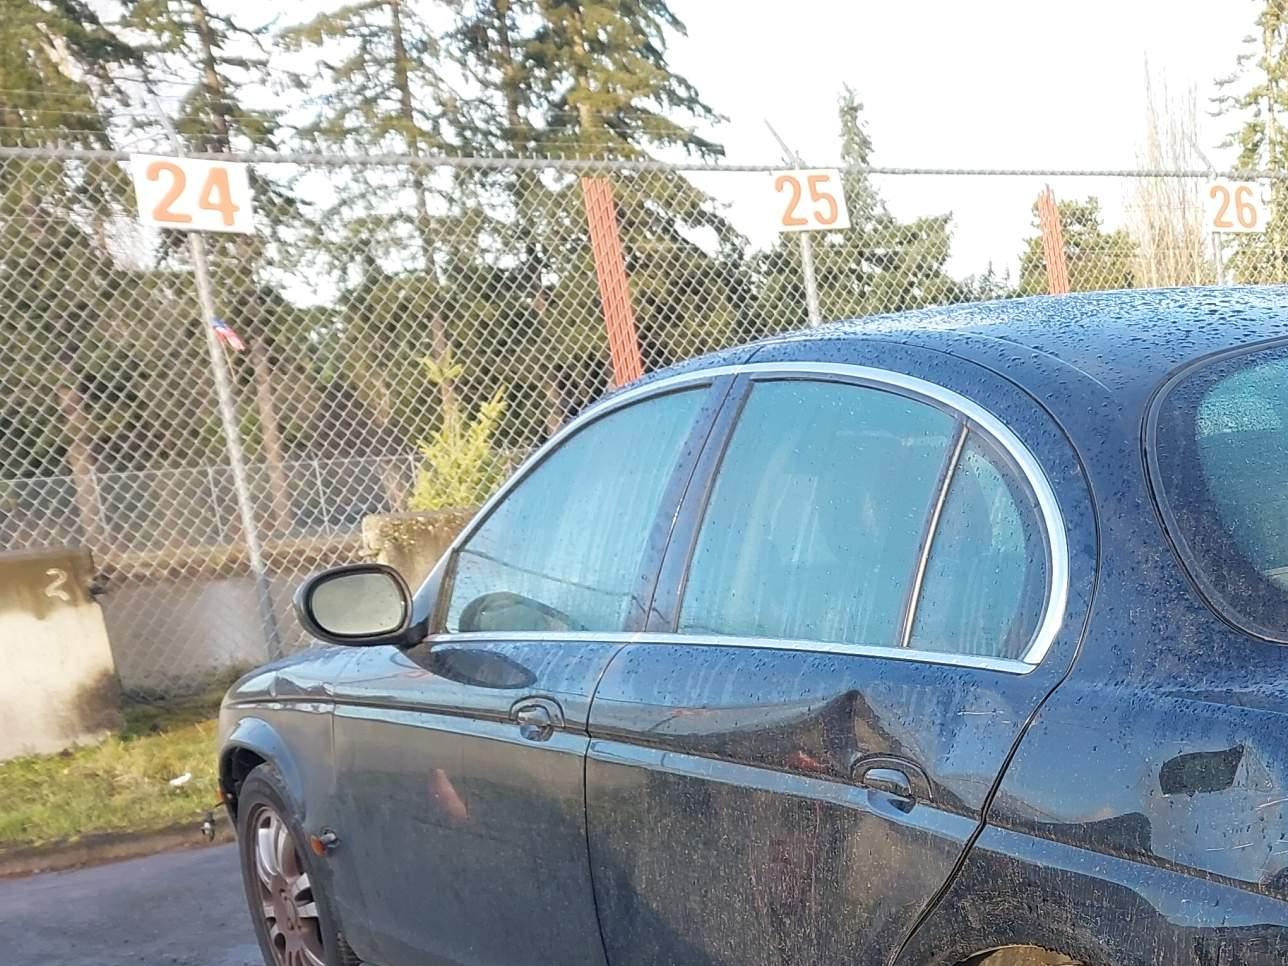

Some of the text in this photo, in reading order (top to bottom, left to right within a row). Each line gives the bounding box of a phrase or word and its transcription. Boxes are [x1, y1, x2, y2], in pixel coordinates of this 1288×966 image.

[146, 161, 240, 225] 24
[775, 175, 838, 225] 25
[1210, 185, 1257, 228] 26
